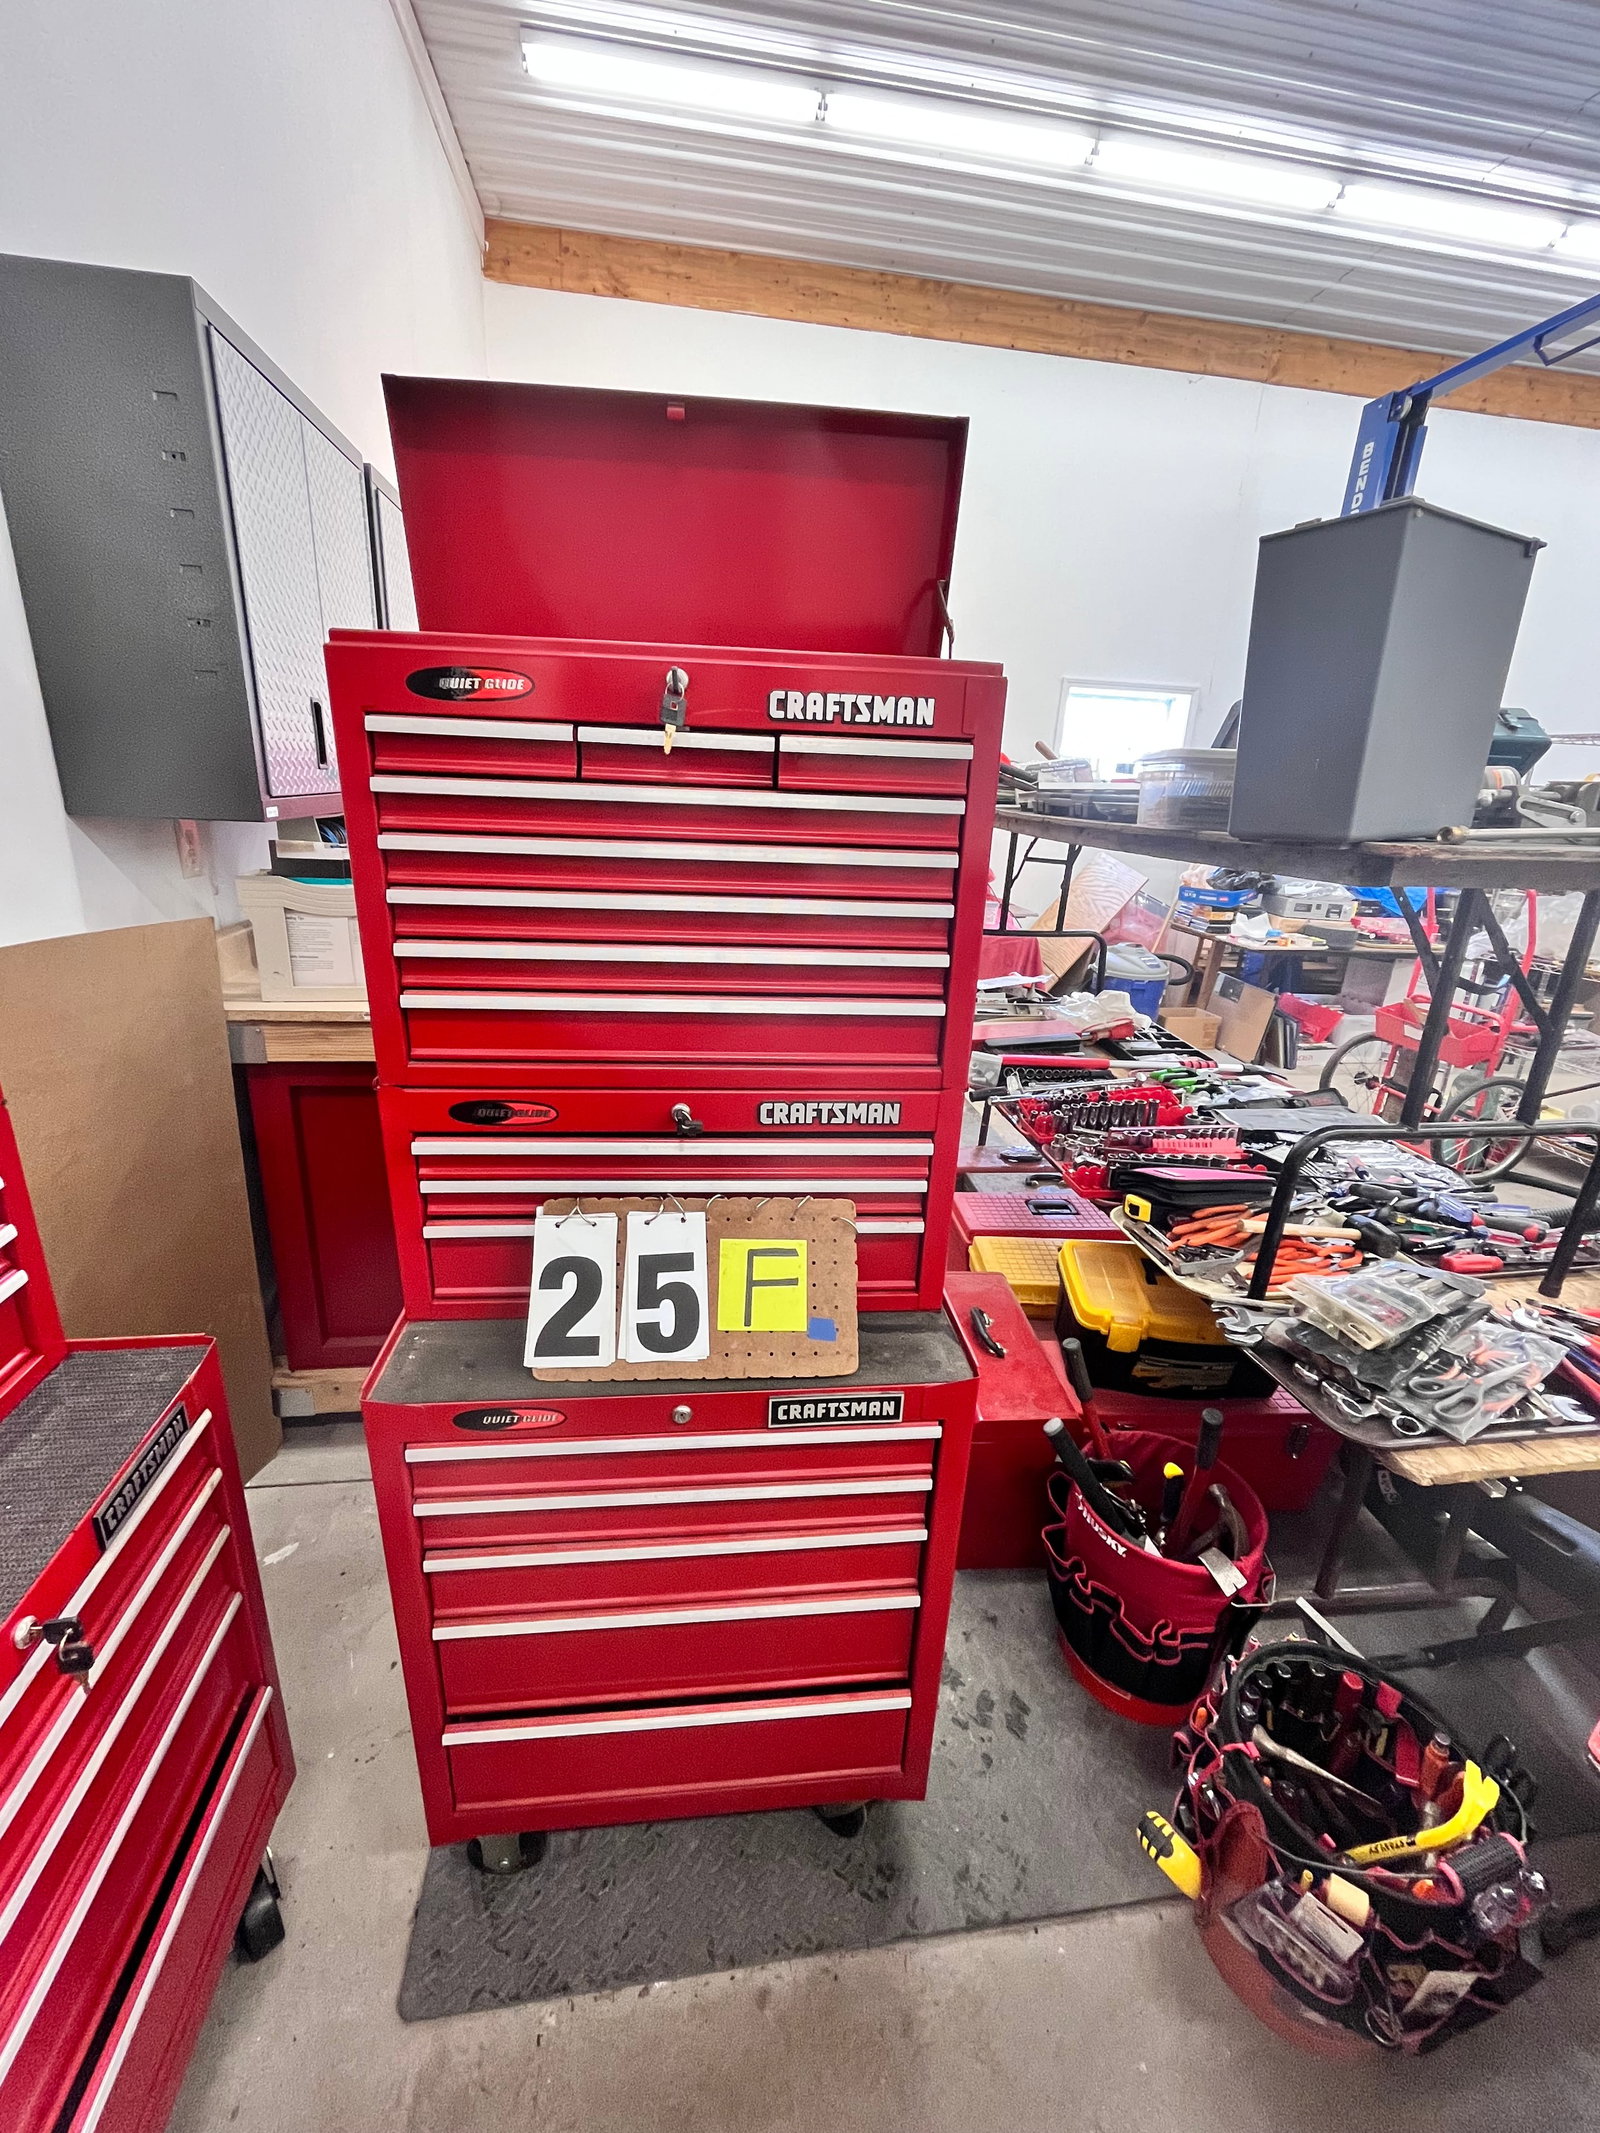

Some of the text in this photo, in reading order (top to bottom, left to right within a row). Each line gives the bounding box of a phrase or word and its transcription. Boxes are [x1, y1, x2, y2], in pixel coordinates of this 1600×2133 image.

[438, 677, 525, 690] QUIET GLIDE
[768, 689, 936, 726] CRAFTSMAN
[758, 1101, 901, 1125] CRAFTSMAN
[743, 1247, 800, 1328] F
[482, 1413, 559, 1425] QUIET GLIDE
[777, 1400, 896, 1421] CRAFTSMAN
[103, 1413, 184, 1531] CRAFTSMAN
[1081, 1506, 1128, 1557] HUSKY
